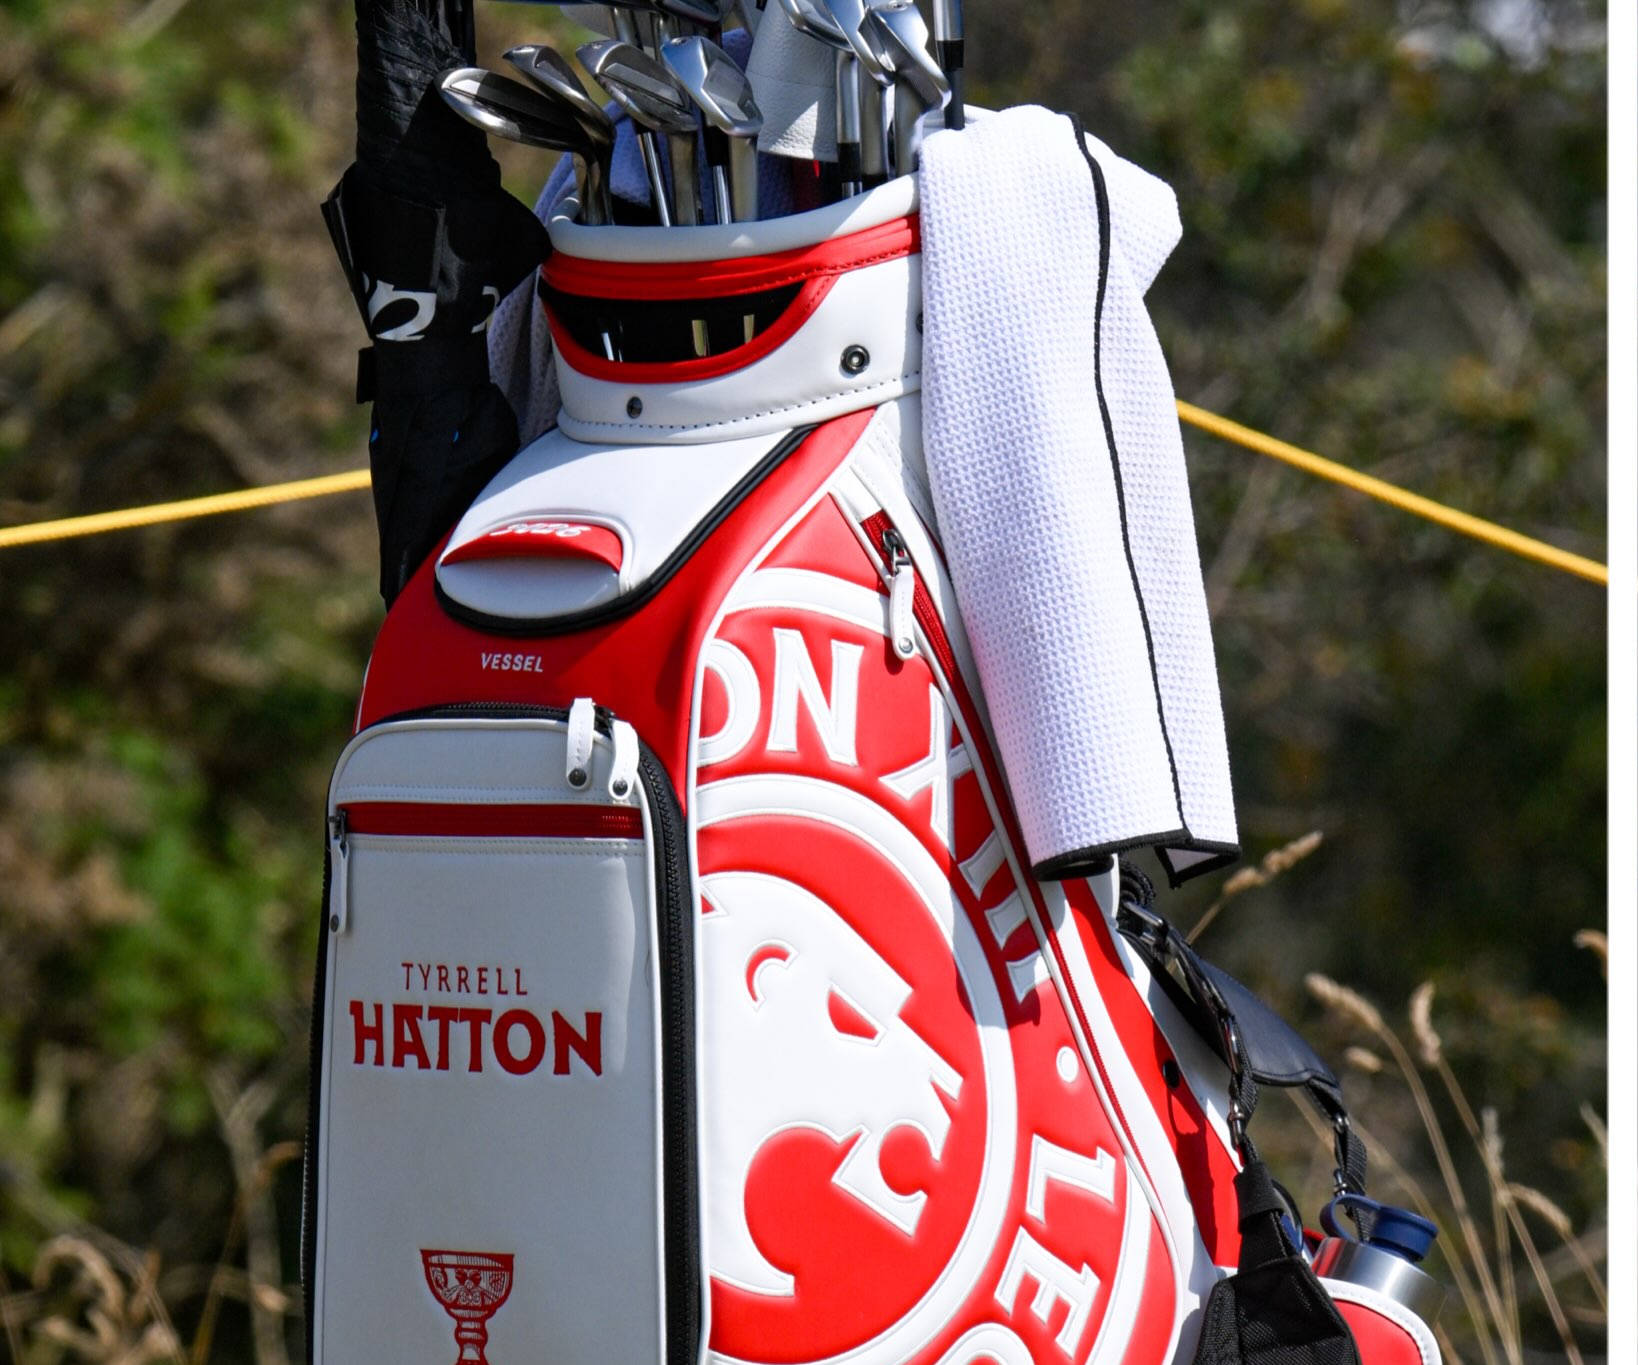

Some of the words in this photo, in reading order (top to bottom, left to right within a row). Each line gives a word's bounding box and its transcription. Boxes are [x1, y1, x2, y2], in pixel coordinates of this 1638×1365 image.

[480, 653, 543, 673] VESSEL
[402, 962, 529, 997] TYRRELL
[349, 1001, 603, 1077] HATTON
